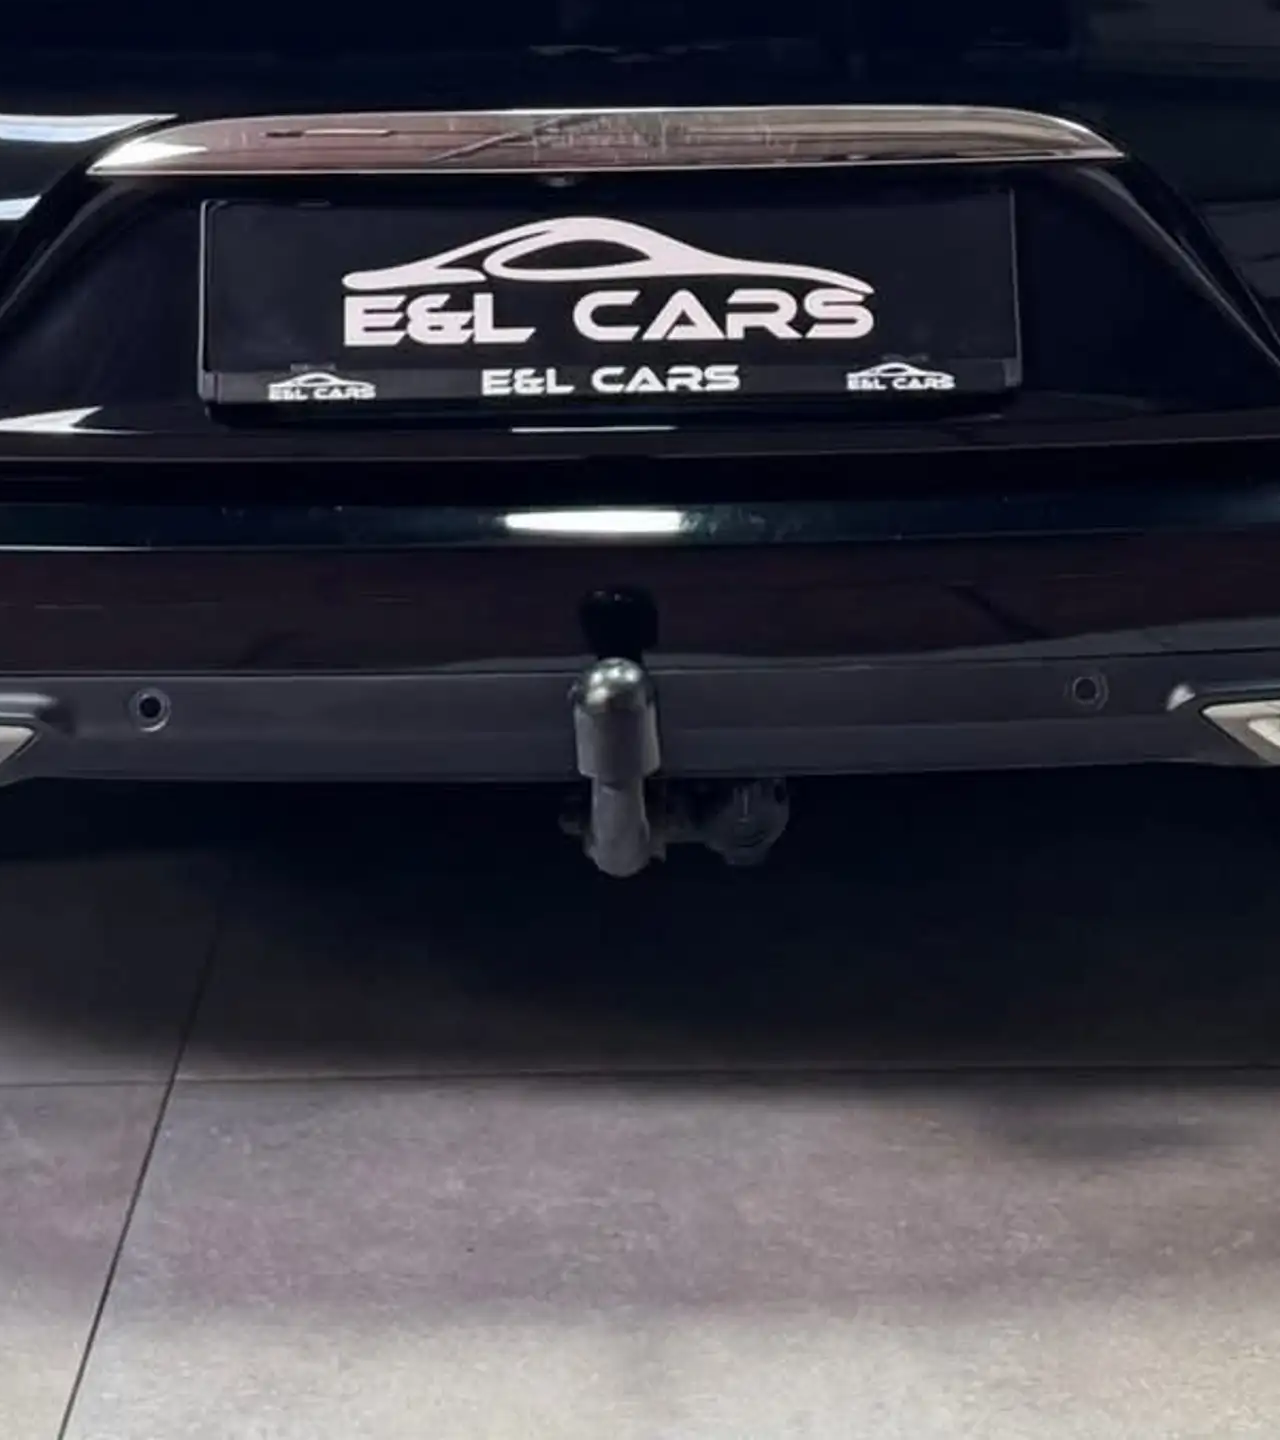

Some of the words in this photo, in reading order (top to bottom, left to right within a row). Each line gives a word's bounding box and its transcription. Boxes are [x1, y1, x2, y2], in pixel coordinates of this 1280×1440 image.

[343, 291, 537, 348] E&L
[572, 290, 875, 343] CARS
[481, 366, 576, 398] E&L
[590, 363, 742, 395] CARS
